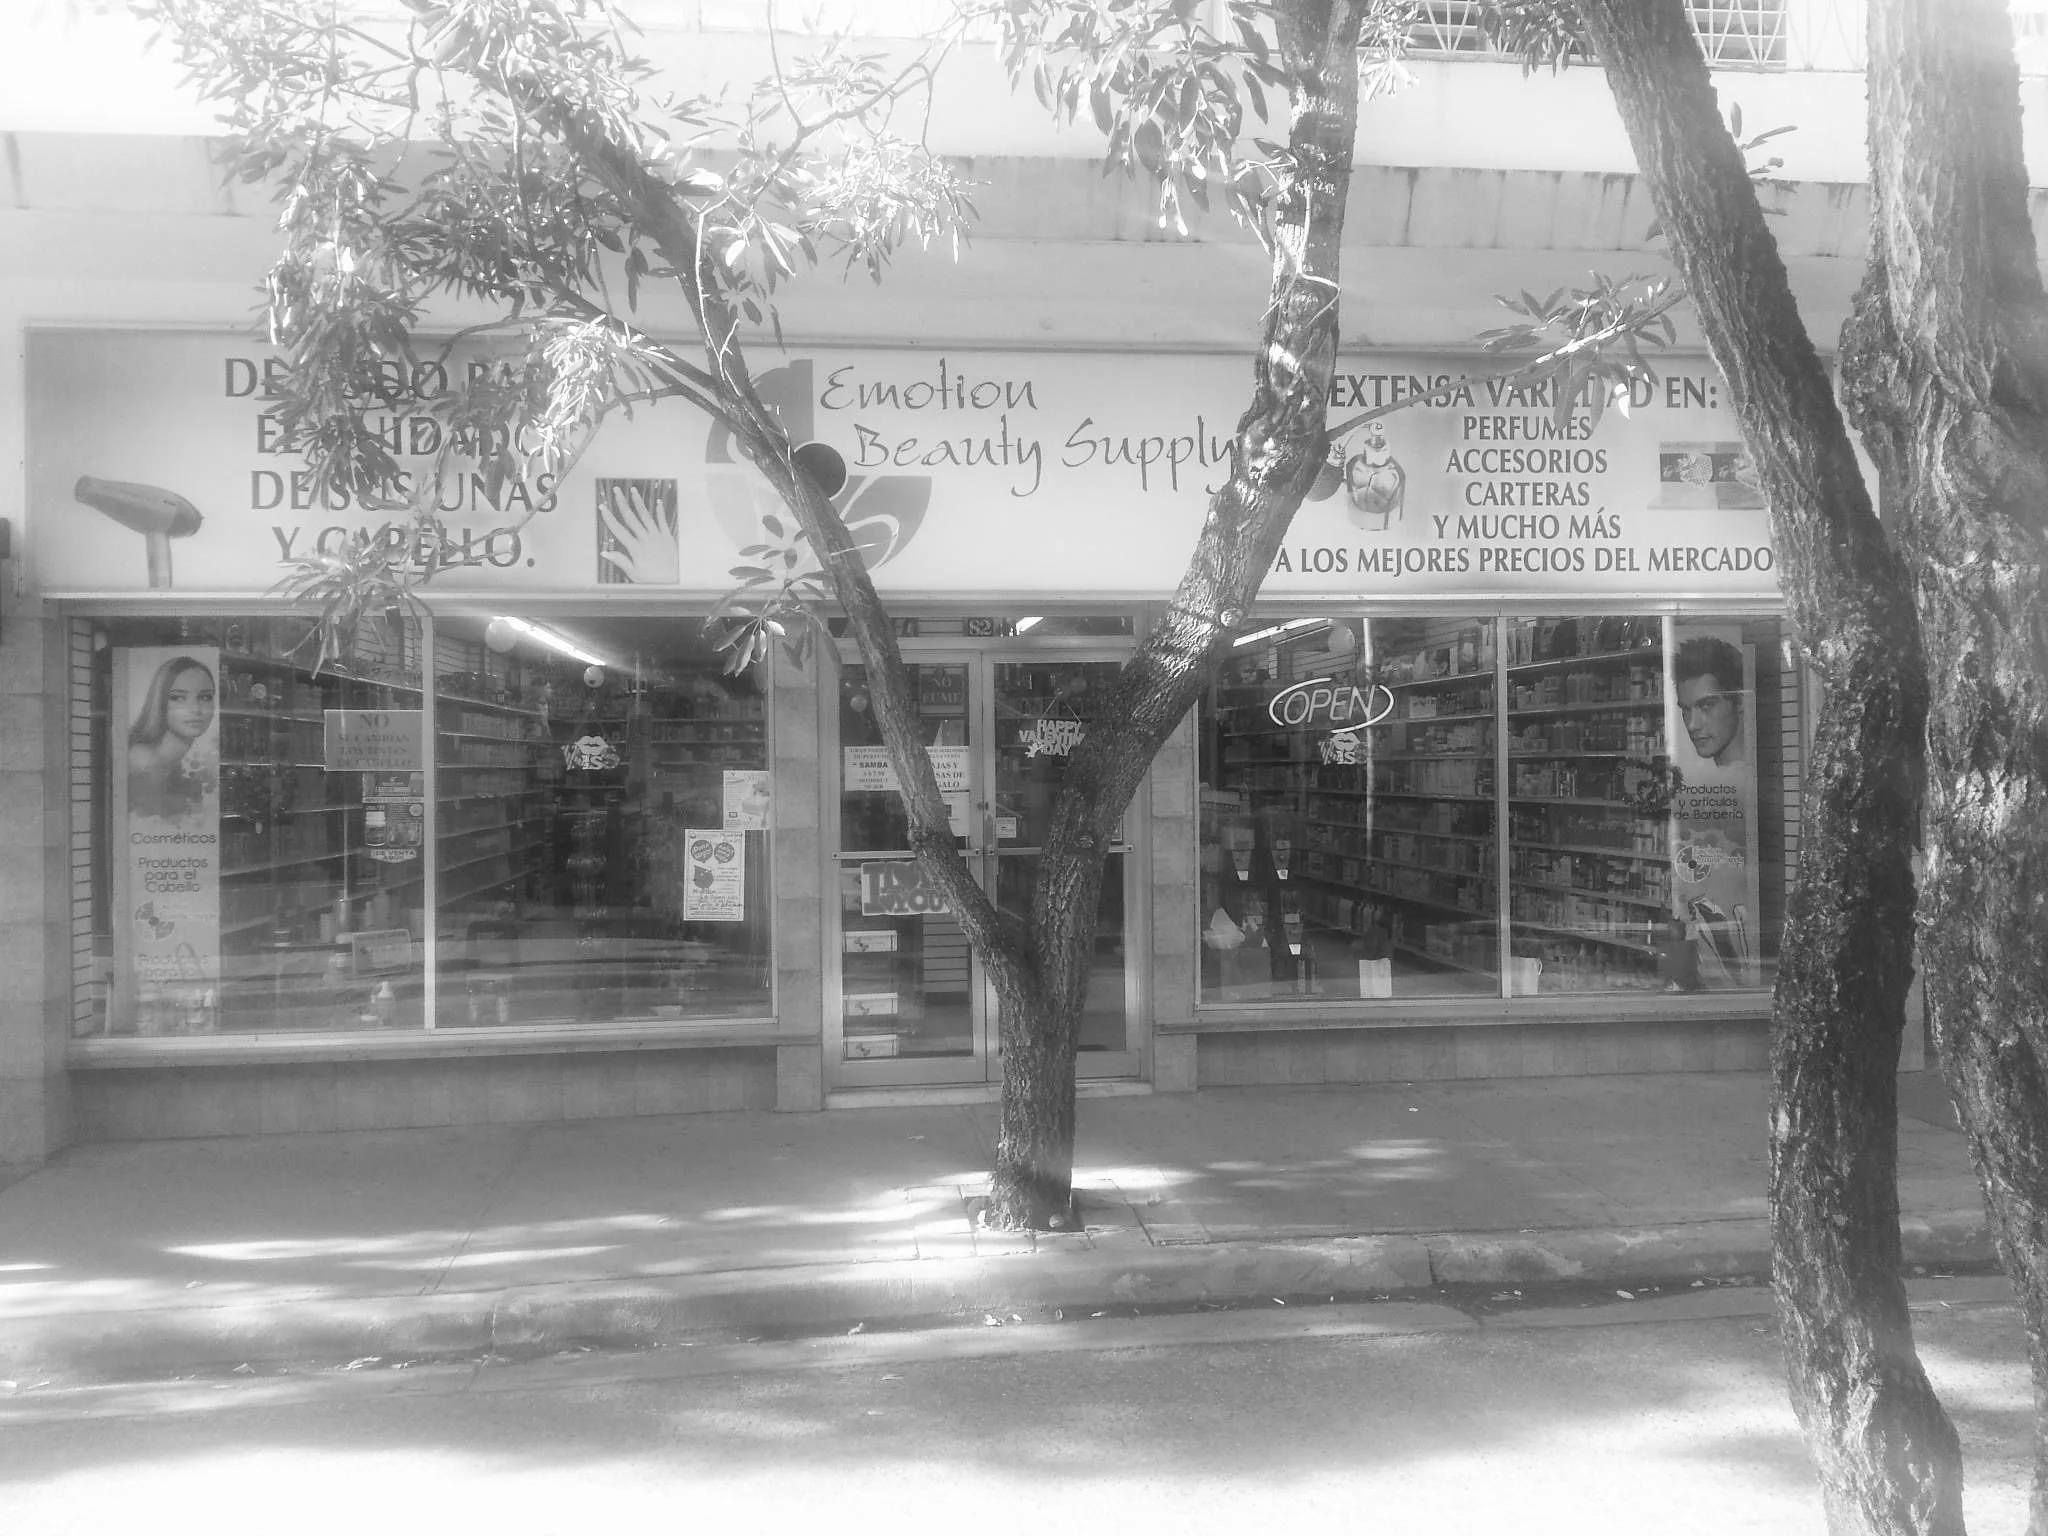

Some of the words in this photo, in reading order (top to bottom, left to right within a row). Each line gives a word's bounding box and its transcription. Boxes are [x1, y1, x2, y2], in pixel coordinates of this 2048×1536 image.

[820, 357, 1039, 411] Emotion
[1331, 374, 1475, 408] EXTENSA
[1666, 376, 1718, 409] EN:
[1463, 415, 1593, 441] PERFUMES
[852, 413, 1043, 498] Beauty
[1060, 414, 1237, 494] Supply
[1446, 448, 1608, 474] ACCESORIOS
[251, 470, 311, 510] DE
[1465, 481, 1591, 507] CARTERAS
[1432, 514, 1452, 539] Y
[1457, 513, 1560, 539] MUCHO
[1568, 507, 1622, 539] MÁS
[271, 526, 301, 563] Y
[1275, 548, 1294, 573] A
[1300, 548, 1348, 573] LOS
[1357, 548, 1470, 577] MEJORES
[1479, 547, 1588, 573] PRECIOS
[1594, 547, 1640, 573] DEL
[1648, 546, 1774, 573] MERCADO
[1283, 684, 1376, 725] OPEN
[360, 714, 391, 731] NO
[1037, 719, 1081, 737] HAPPY
[1042, 743, 1072, 757] DAY
[1680, 784, 1737, 794] Productos
[139, 857, 209, 869] Productos
[144, 871, 179, 882] para
